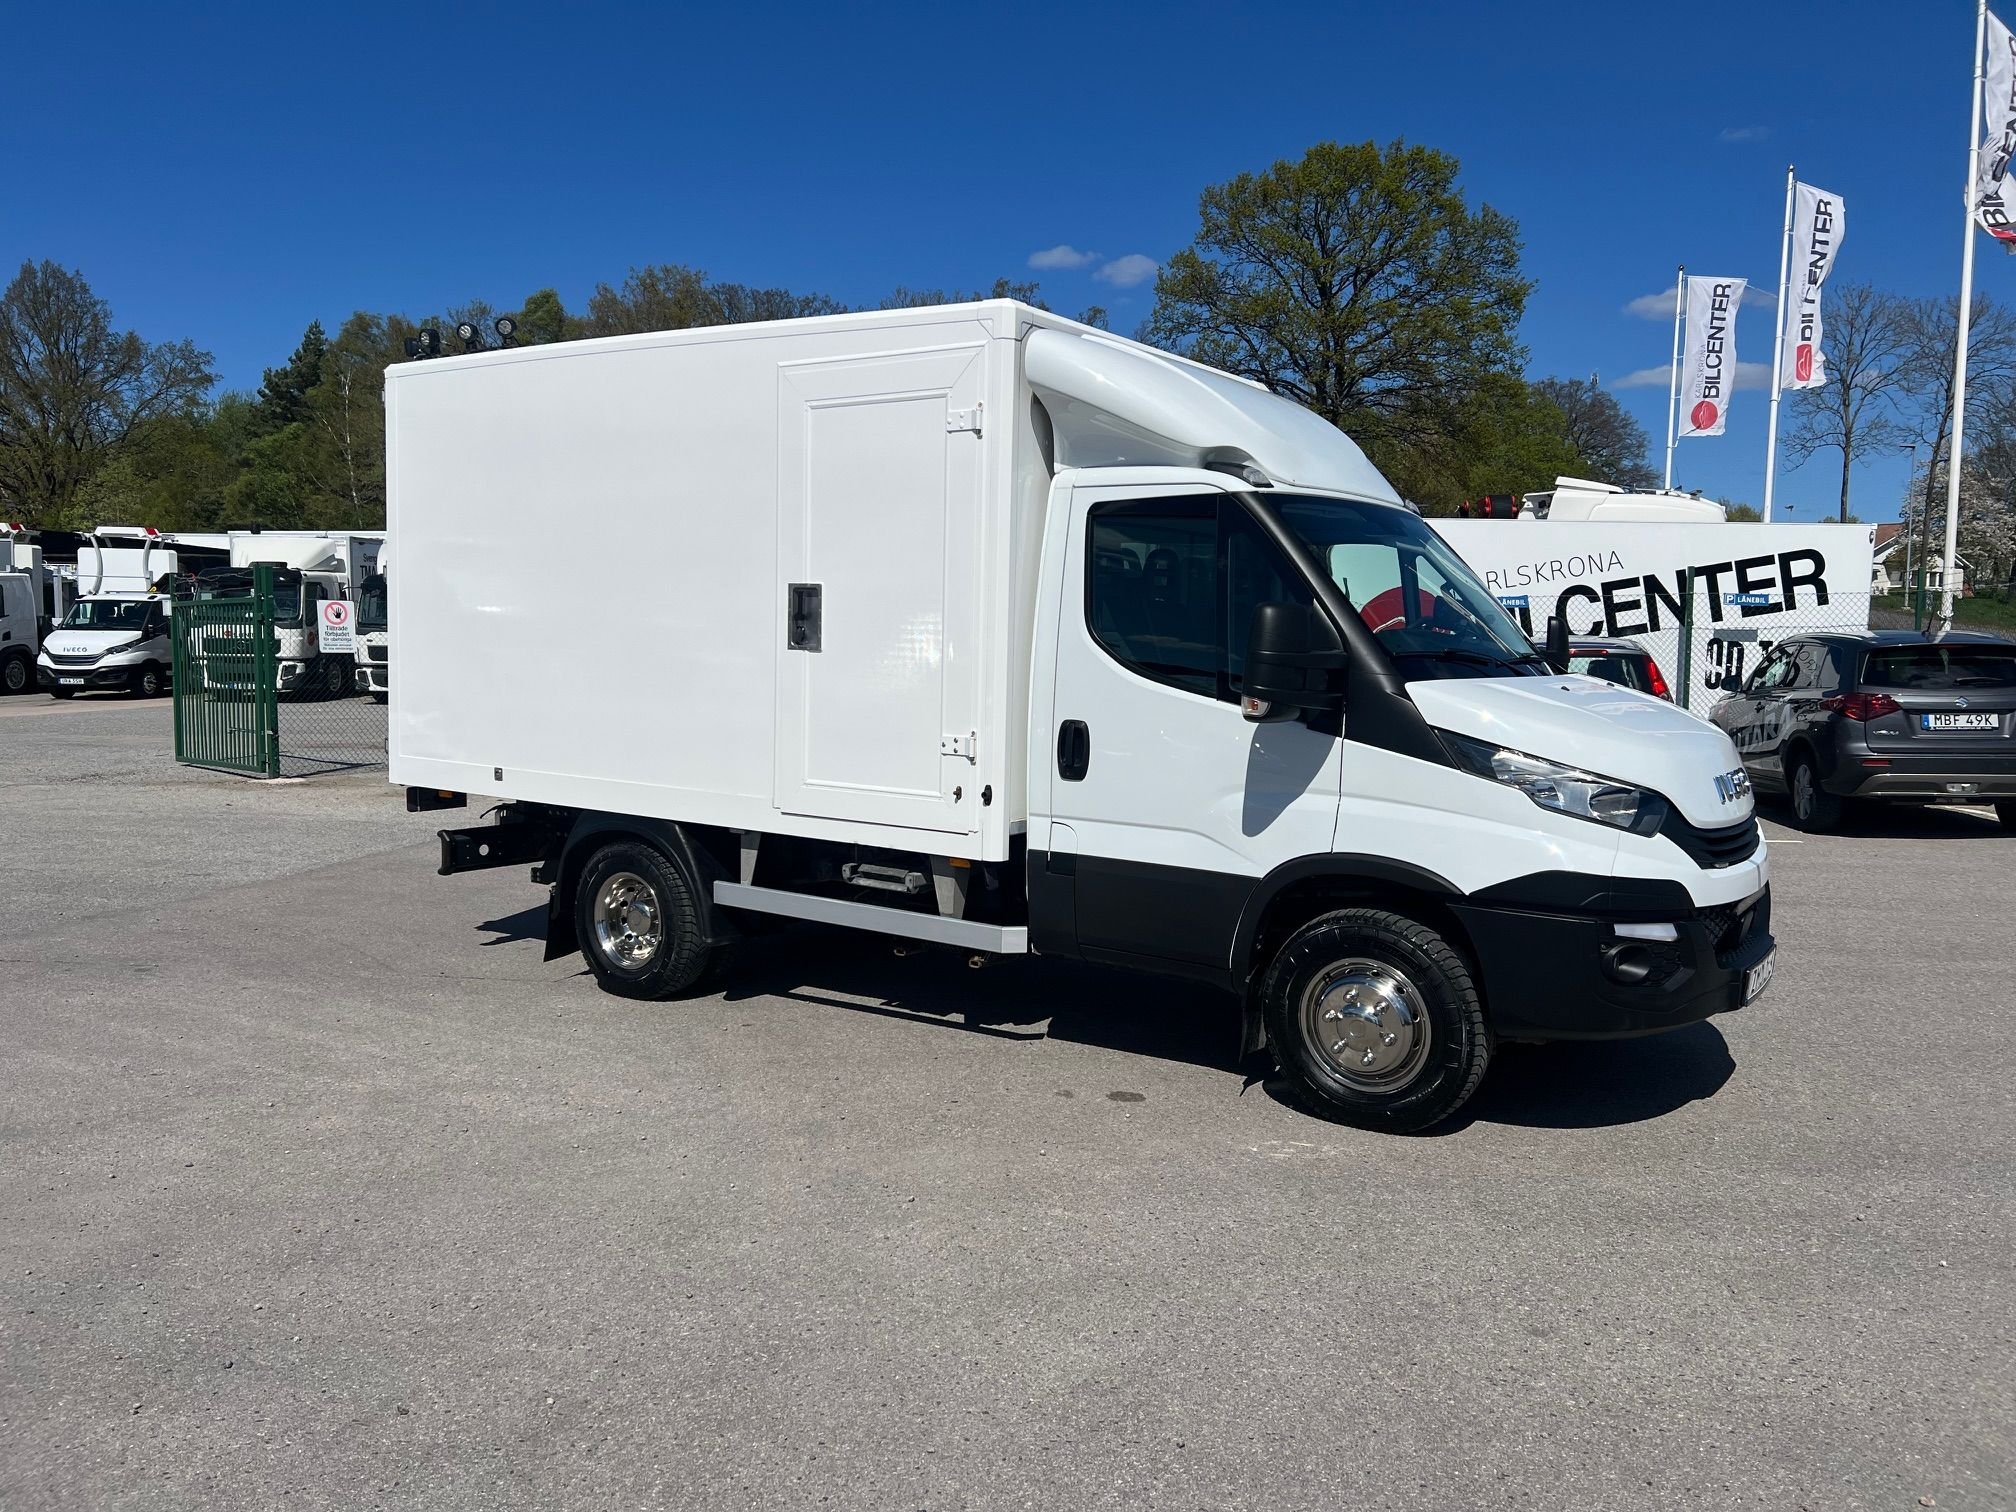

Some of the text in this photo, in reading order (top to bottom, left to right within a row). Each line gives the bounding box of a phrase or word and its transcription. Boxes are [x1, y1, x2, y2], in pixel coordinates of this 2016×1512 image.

[1703, 283, 1731, 399] BILCENTER
[1485, 550, 1625, 590] RLSKRONA
[1502, 597, 1526, 606] ÅNEBIL
[1505, 548, 1830, 638] CENTER
[1934, 714, 1993, 726] MBF 49K
